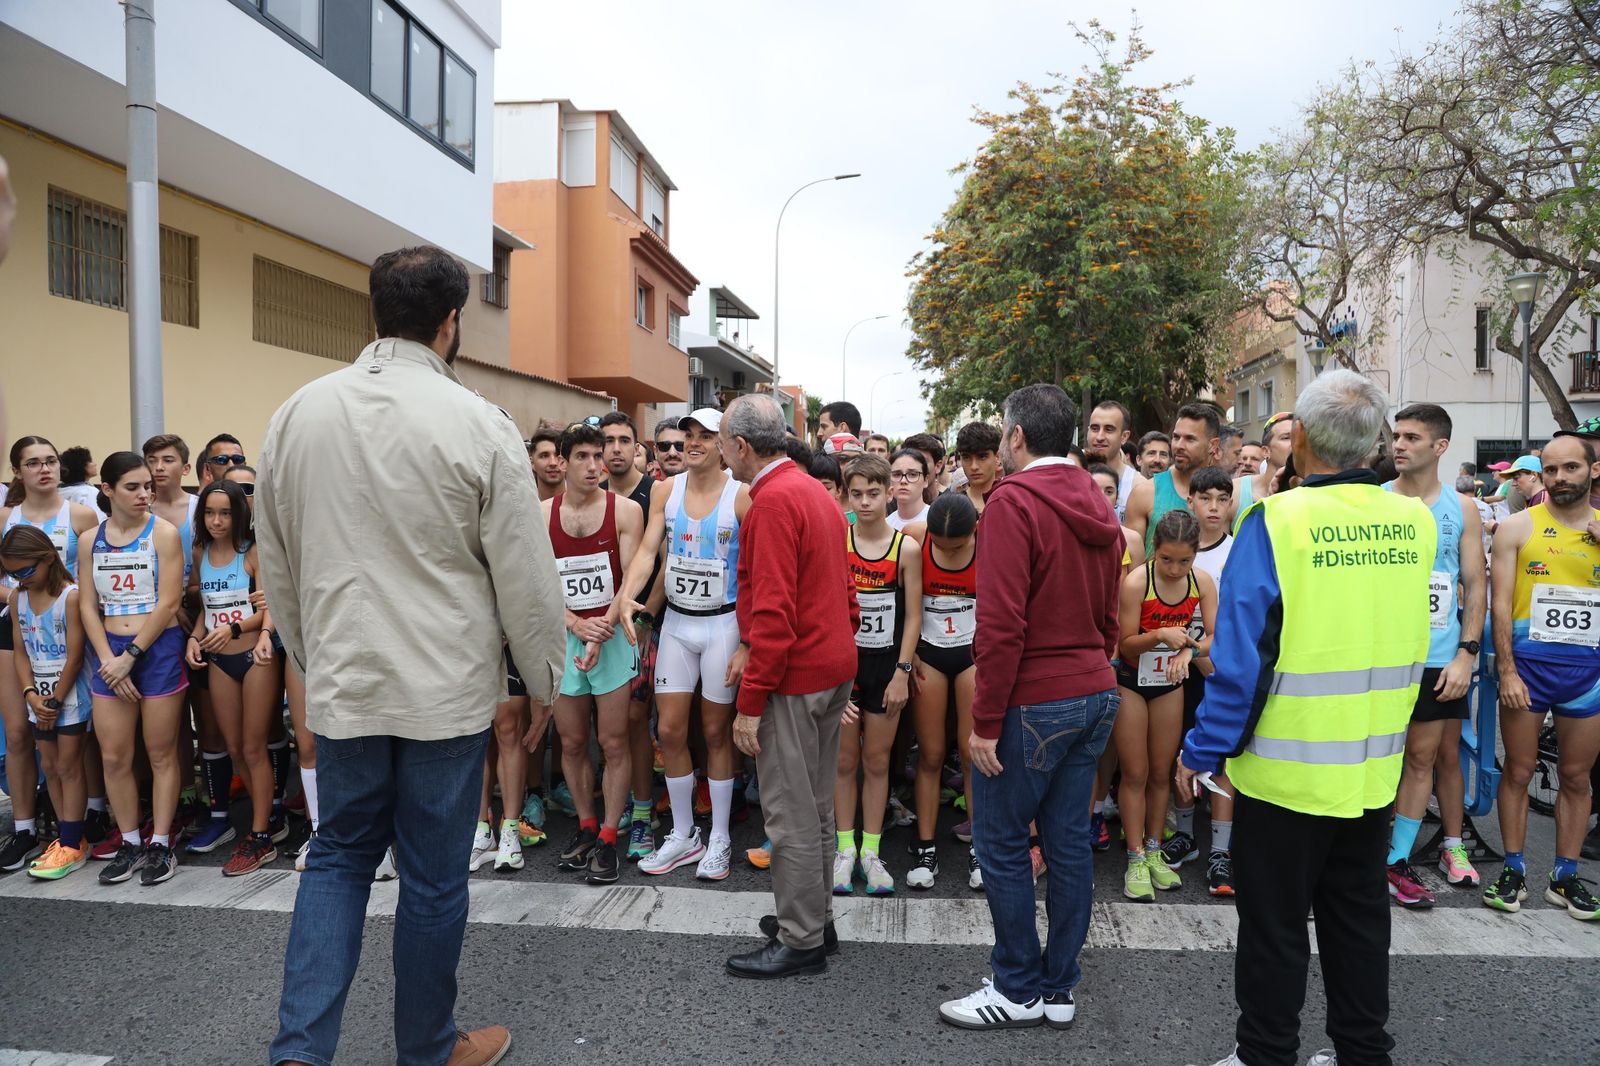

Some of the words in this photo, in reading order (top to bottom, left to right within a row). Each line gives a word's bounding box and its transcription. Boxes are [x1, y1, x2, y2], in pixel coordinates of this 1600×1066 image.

[1310, 524, 1416, 543] VOLUNTARIO
[1312, 547, 1418, 568] #DistritoEste
[110, 573, 136, 591] 24
[566, 575, 605, 597] 504
[675, 576, 711, 597] 571
[943, 616, 956, 634] 1
[1545, 608, 1592, 630] 863
[24, 640, 66, 656] laga
